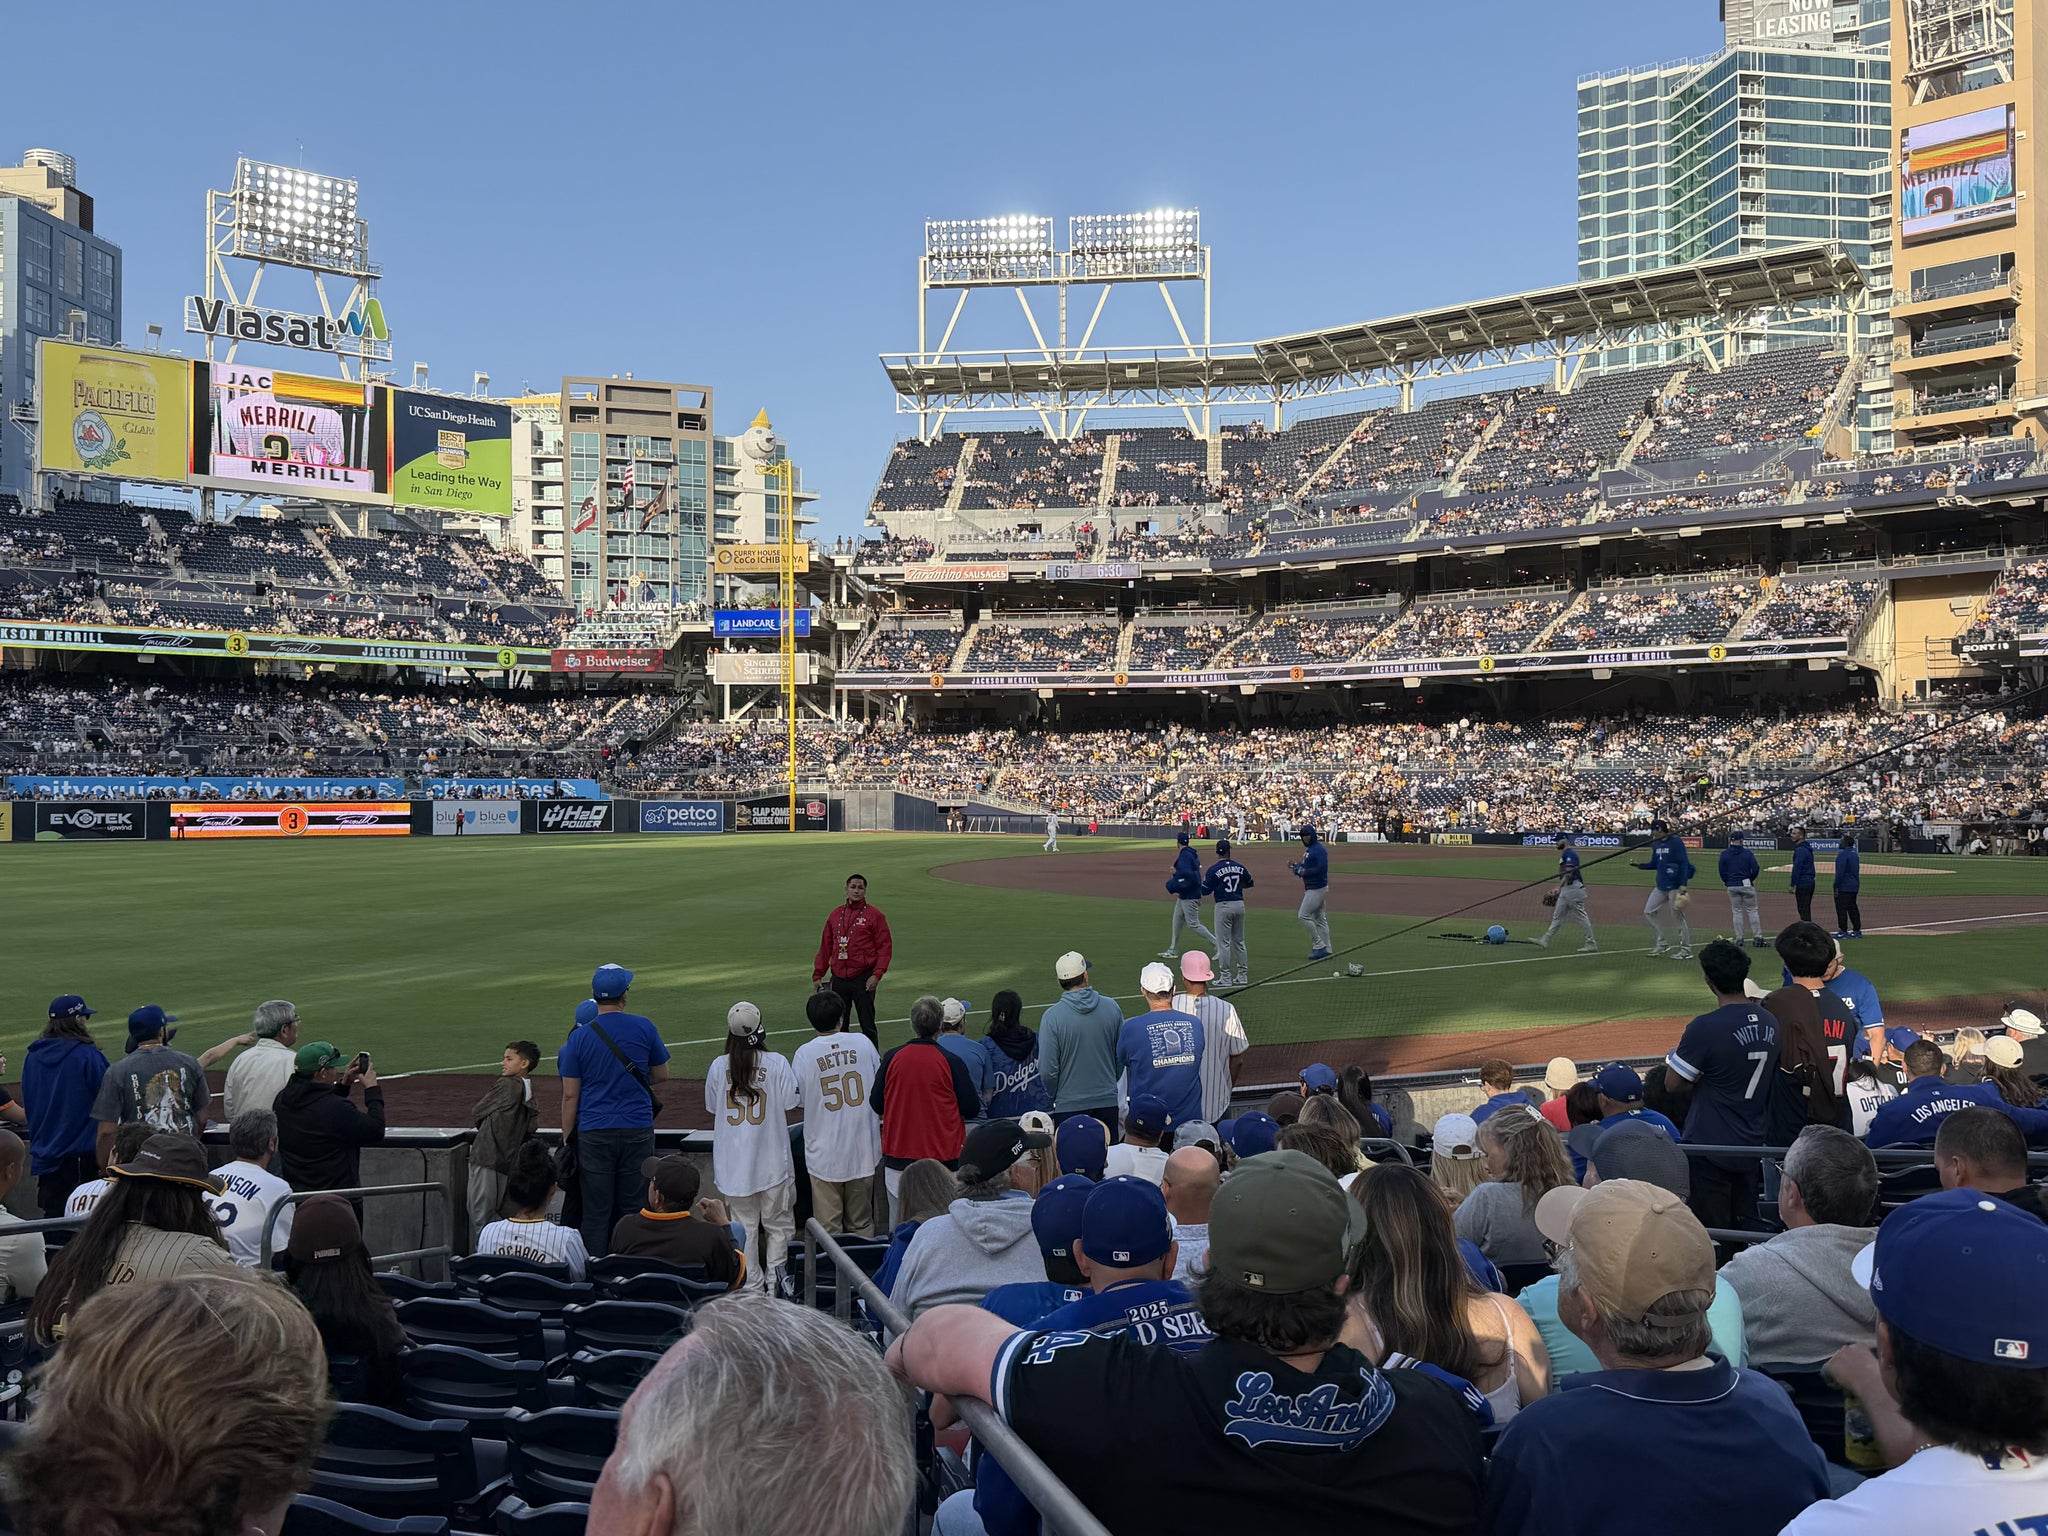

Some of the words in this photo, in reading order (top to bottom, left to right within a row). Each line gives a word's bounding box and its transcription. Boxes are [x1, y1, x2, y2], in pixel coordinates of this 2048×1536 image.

[1755, 11, 1831, 39] LEASING
[194, 295, 333, 350] Viasat
[74, 379, 157, 415] PACIFICO
[240, 405, 317, 435] MERRILL
[409, 405, 424, 418] UC
[424, 407, 441, 420] San
[442, 410, 467, 425] Diego
[468, 414, 496, 427] Health
[439, 431, 464, 443] BEST
[251, 460, 355, 483] MERRILL
[410, 468, 455, 485] Leading
[458, 474, 475, 485] the
[478, 476, 502, 490] Way
[410, 483, 420, 493] in
[424, 485, 443, 496] San
[446, 487, 473, 500] Diego
[733, 556, 756, 564] CoCo
[758, 549, 780, 557] HOUSE
[907, 567, 963, 580] Tarantino
[963, 569, 1007, 579] SAUSAGES
[1097, 565, 1123, 578] 6:30
[732, 618, 776, 628] LANDCARE
[0, 627, 38, 641] KSON
[44, 630, 104, 644] MERRILL
[232, 637, 241, 652] 3
[1962, 643, 1998, 652] SONY
[361, 646, 415, 659] JACKSON
[419, 650, 468, 661] MERRILL
[503, 652, 510, 665] 3
[586, 654, 651, 667] Budweiser
[1587, 653, 1628, 663] JACKSON
[1631, 651, 1671, 661] MERRILL
[1370, 665, 1405, 674] JACKSON
[436, 811, 456, 822] blu
[479, 811, 506, 822] blue
[667, 805, 717, 824] petco
[752, 805, 771, 817] SLAP
[771, 805, 790, 817] SOME
[288, 812, 298, 829] 3
[560, 820, 602, 829] POWER
[752, 816, 773, 825] CHEESE
[773, 816, 782, 825] ON
[783, 816, 790, 825] IT
[1588, 836, 1620, 848] petco
[1223, 874, 1240, 893] 37
[1733, 1024, 1760, 1046] WITT
[816, 1050, 857, 1072] BETTS
[1152, 1055, 1196, 1066] CHAMPIONS
[1744, 1051, 1769, 1100] 7
[820, 1070, 865, 1112] 50
[726, 1087, 768, 1127] 50
[1911, 1103, 1933, 1124] LOS
[1129, 1300, 1169, 1323] 2025
[1224, 1371, 1293, 1423] Los
